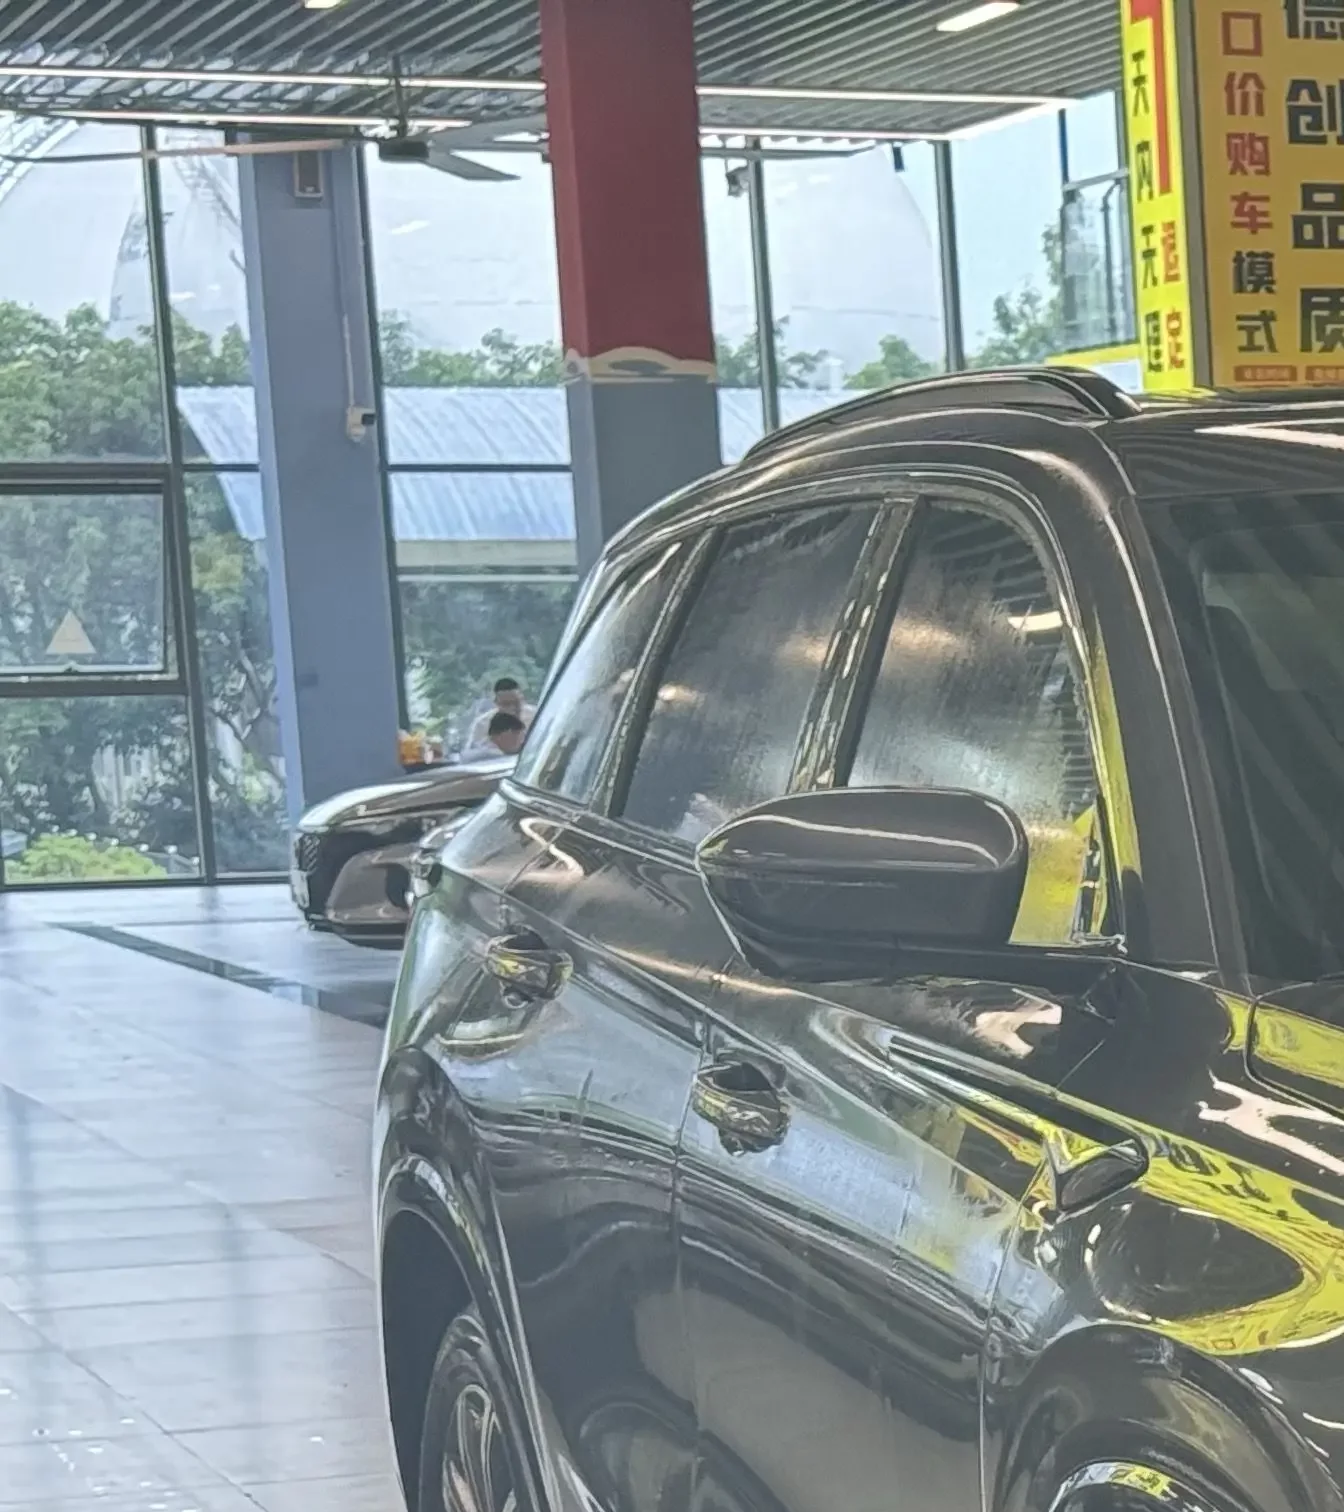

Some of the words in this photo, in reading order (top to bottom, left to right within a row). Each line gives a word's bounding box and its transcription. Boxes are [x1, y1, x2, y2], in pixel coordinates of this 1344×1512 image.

[1221, 11, 1279, 354] 口价购车模式
